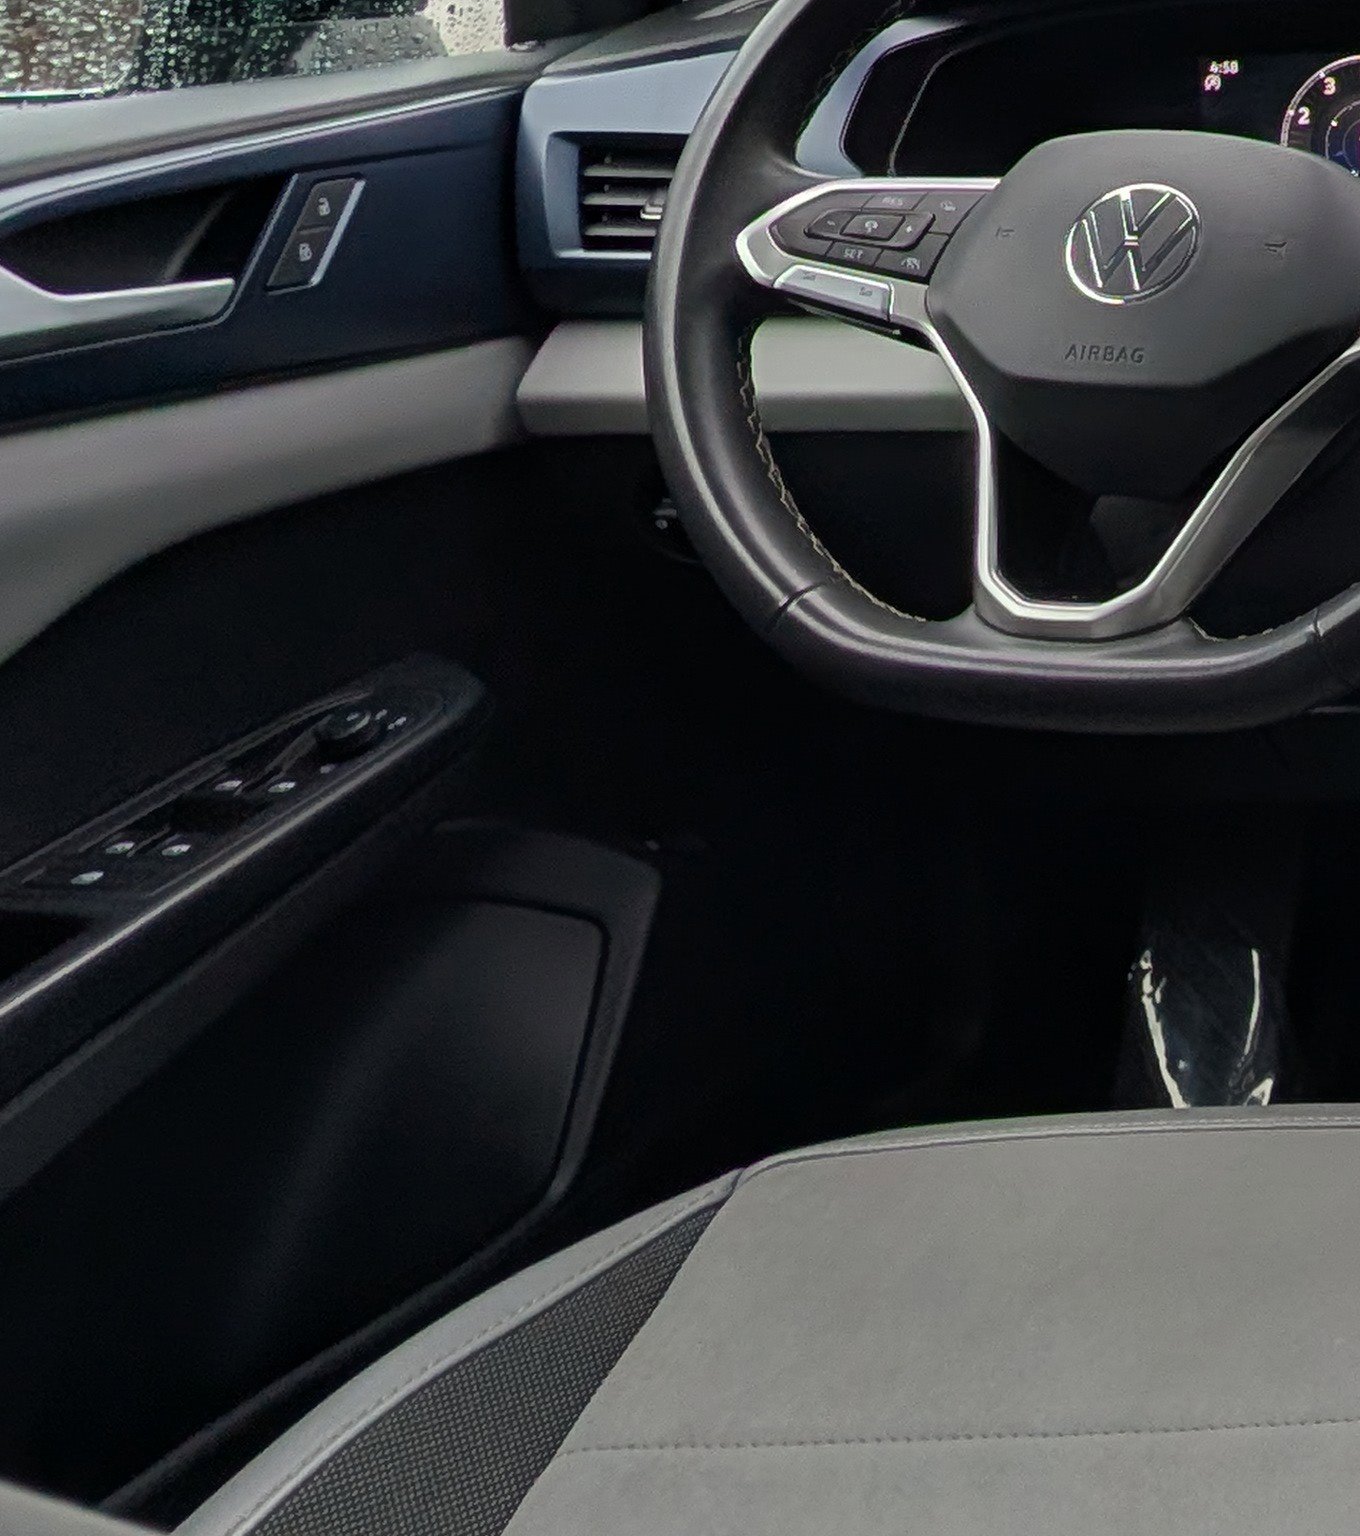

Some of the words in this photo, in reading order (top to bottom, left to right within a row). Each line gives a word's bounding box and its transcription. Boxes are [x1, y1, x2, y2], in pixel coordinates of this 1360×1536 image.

[1322, 77, 1336, 95] 3
[1299, 107, 1311, 125] 2
[1065, 344, 1144, 364] AIRBAG
